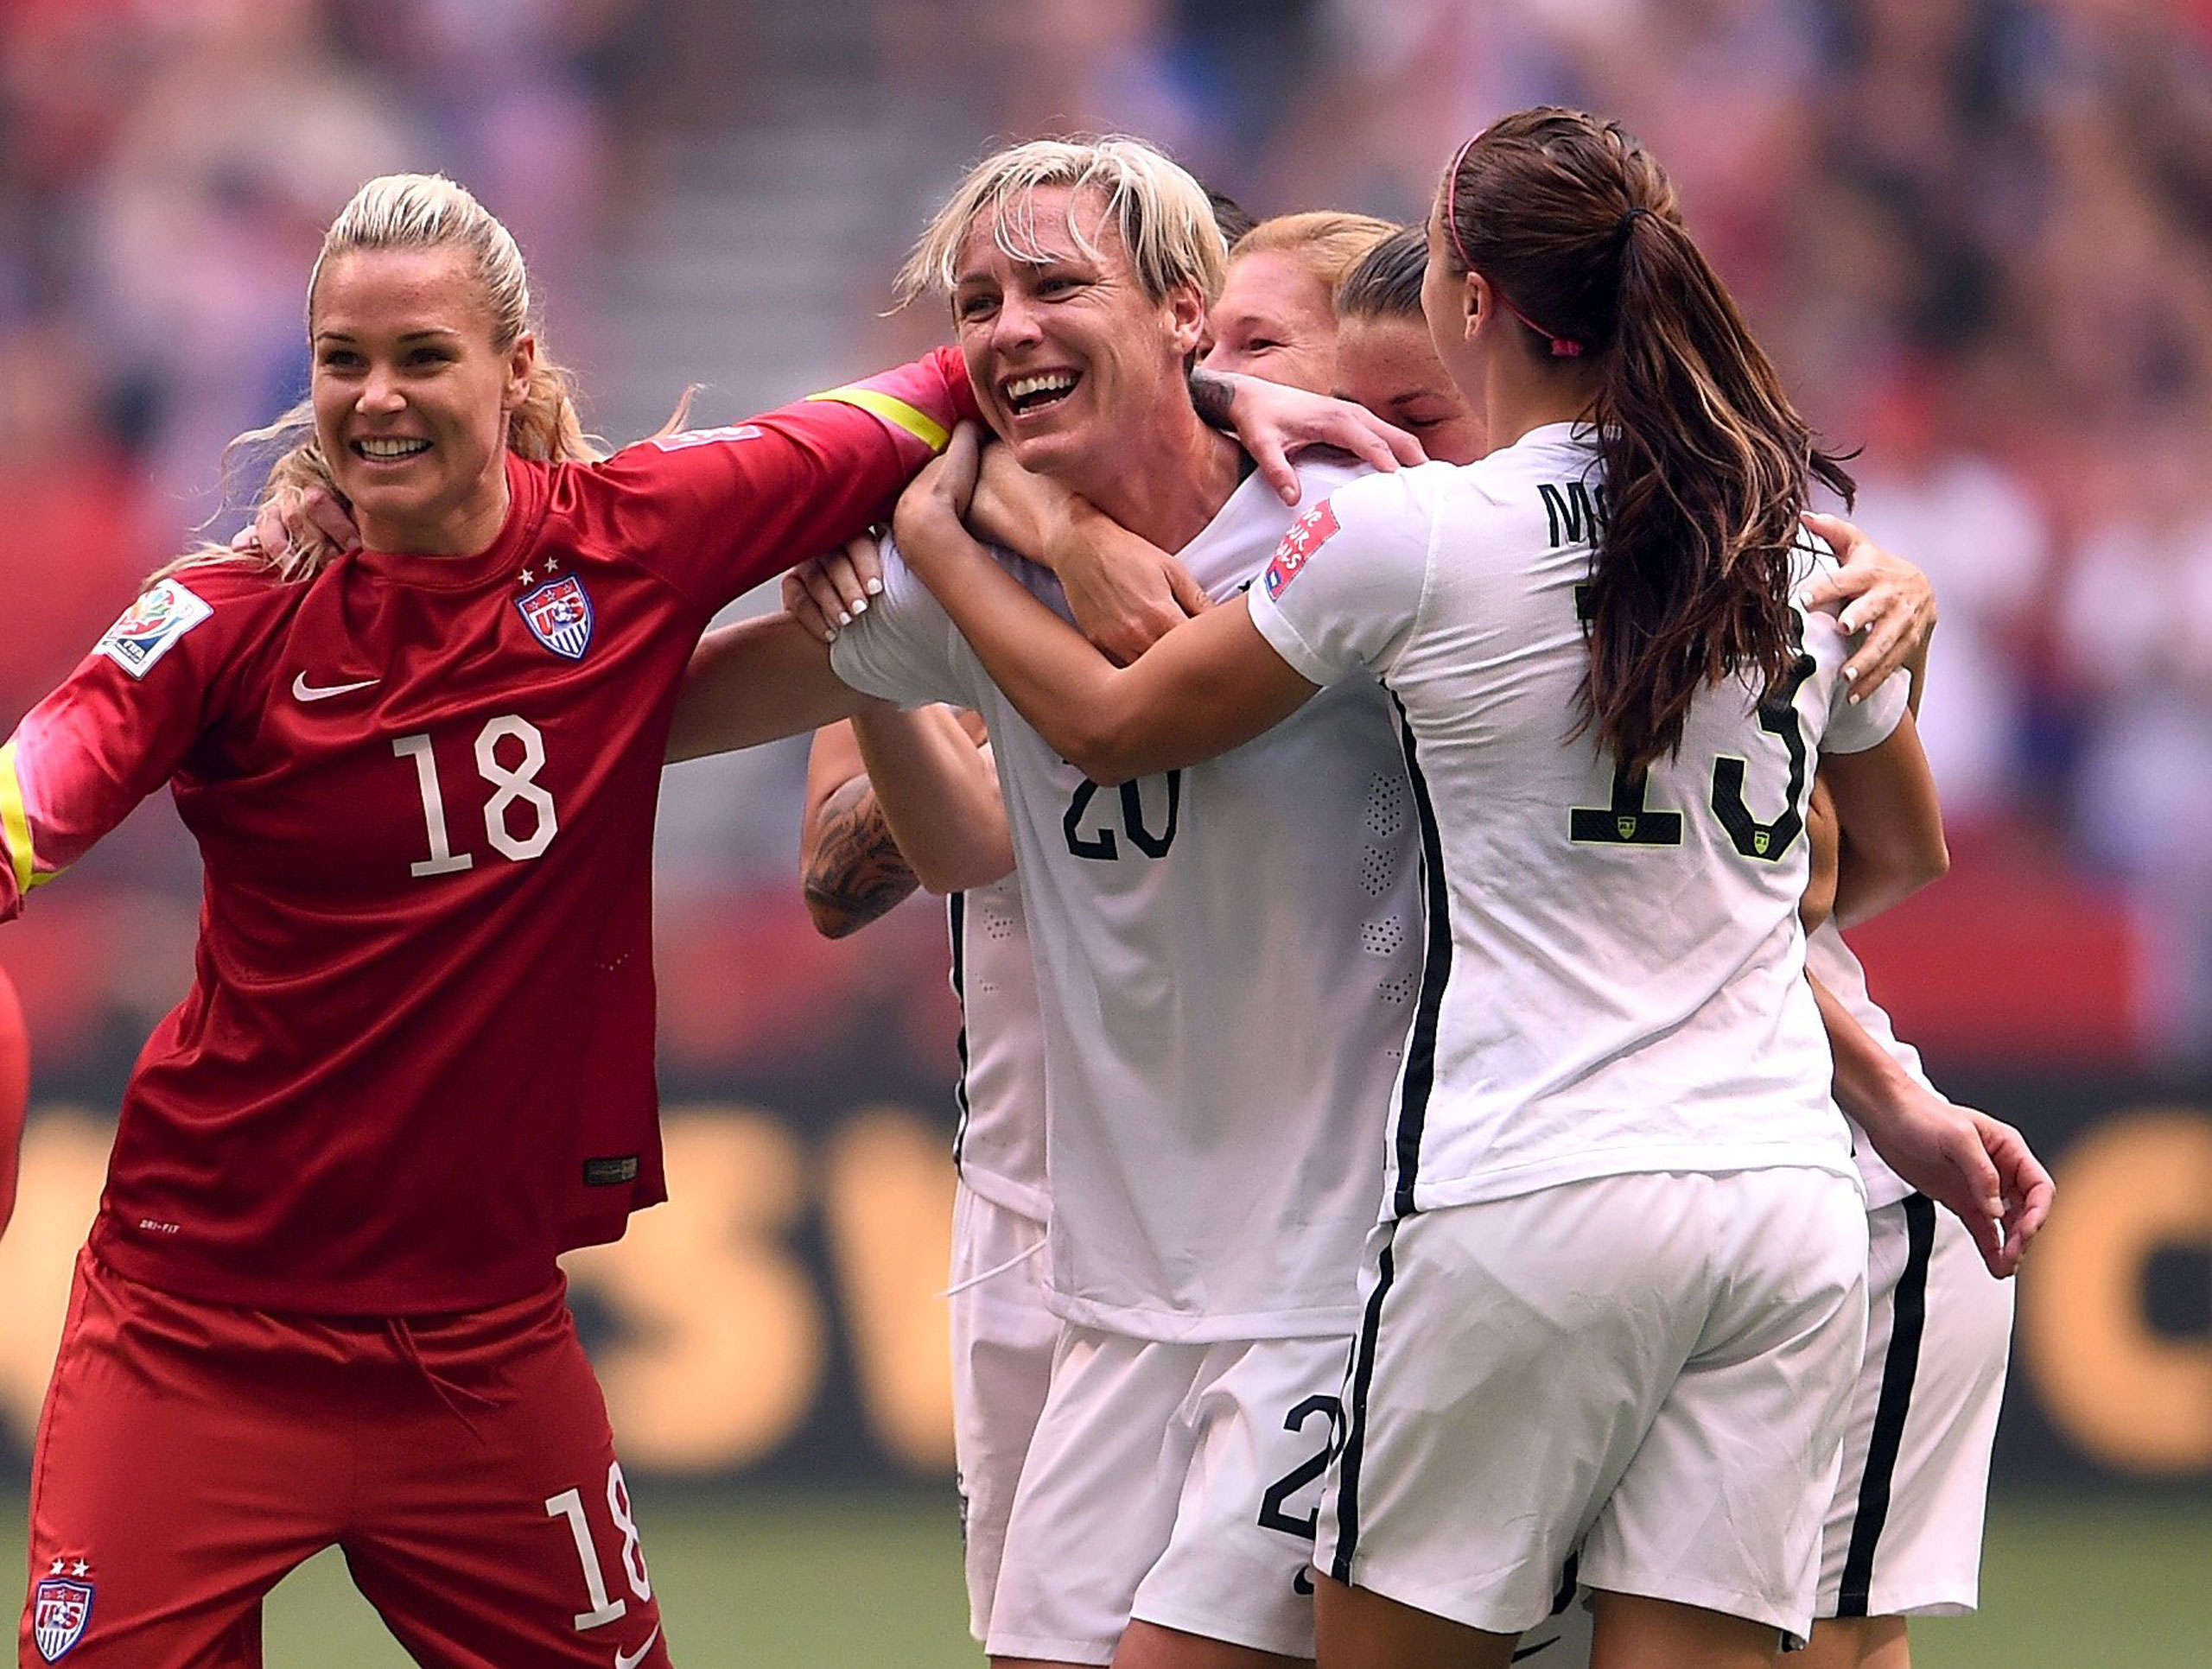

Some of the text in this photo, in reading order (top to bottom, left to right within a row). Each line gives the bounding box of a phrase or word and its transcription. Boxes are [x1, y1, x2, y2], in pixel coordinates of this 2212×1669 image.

[392, 714, 558, 878] 18
[1062, 759, 1180, 860] 20
[544, 1460, 651, 1631] 18
